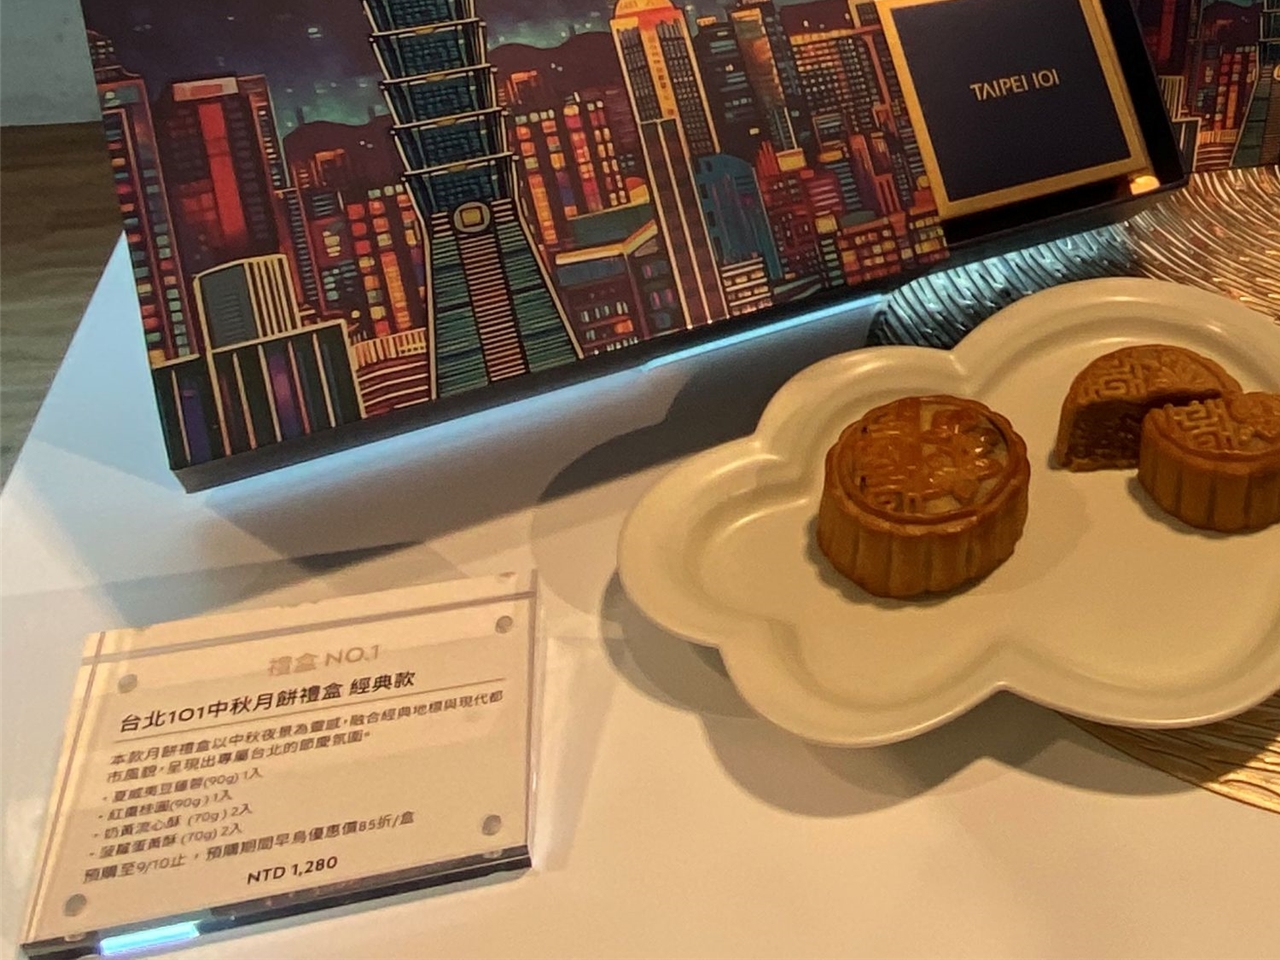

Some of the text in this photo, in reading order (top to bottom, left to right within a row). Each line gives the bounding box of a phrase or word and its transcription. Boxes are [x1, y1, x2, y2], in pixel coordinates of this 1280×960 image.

[969, 74, 1028, 101] TAIPEI
[325, 644, 380, 666] NO.1
[119, 670, 416, 733] 台北101中秋月餅禮盒 經典款
[246, 855, 338, 885] NTD 1,280
